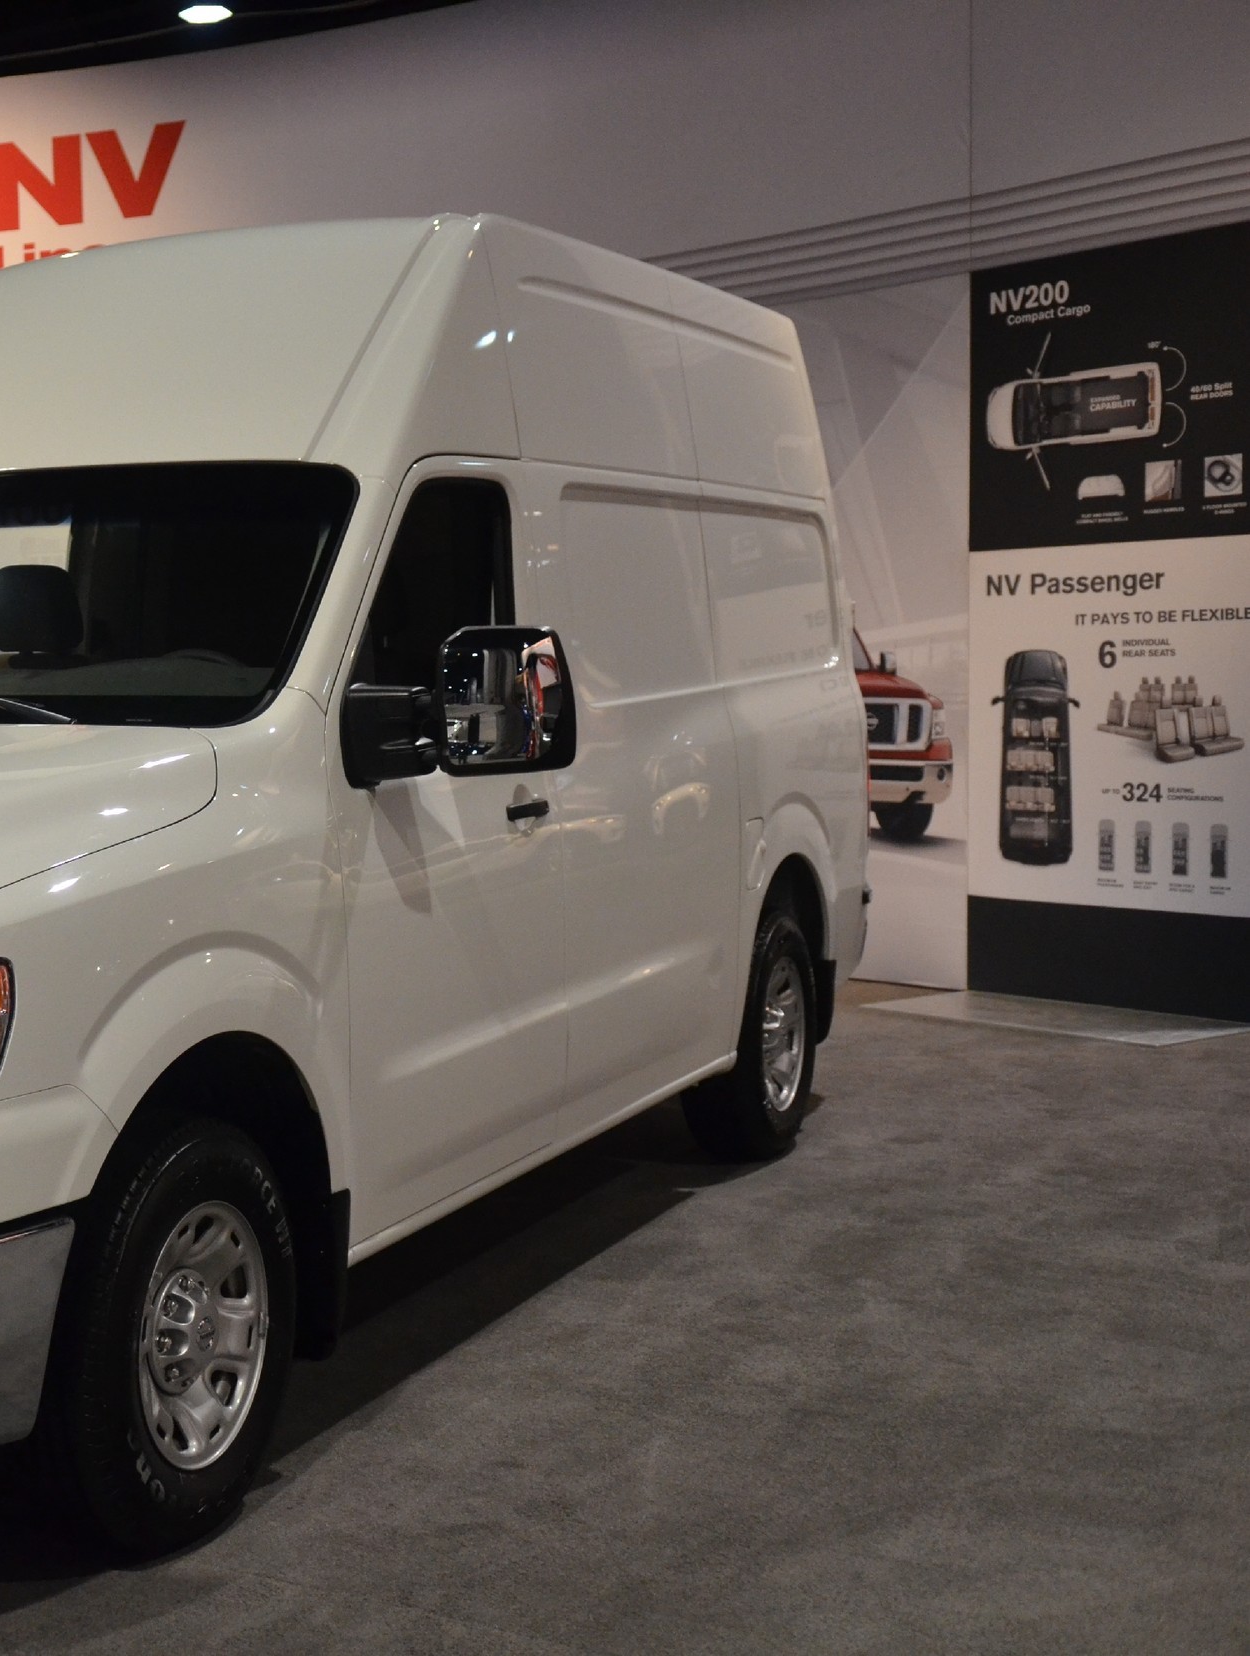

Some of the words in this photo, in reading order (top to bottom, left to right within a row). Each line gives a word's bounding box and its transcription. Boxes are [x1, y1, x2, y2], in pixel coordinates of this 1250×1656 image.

[989, 280, 1070, 315] NV200
[1007, 308, 1055, 326] Compact
[1057, 303, 1091, 319] Cargo
[1089, 399, 1137, 412] CAPABILITY
[986, 574, 1021, 597] NV
[1030, 571, 1165, 597] Passenger
[1075, 613, 1087, 626] IT
[1091, 612, 1130, 626] PAYS
[1133, 611, 1154, 624] TO
[1157, 609, 1177, 623] BE
[1181, 607, 1250, 622] FLEXIBLE
[1122, 638, 1171, 648] INDIVIDUAL
[1122, 649, 1147, 658] REAR
[1148, 648, 1177, 658] SEATS
[1098, 640, 1117, 669] 6
[1122, 782, 1164, 803] 324
